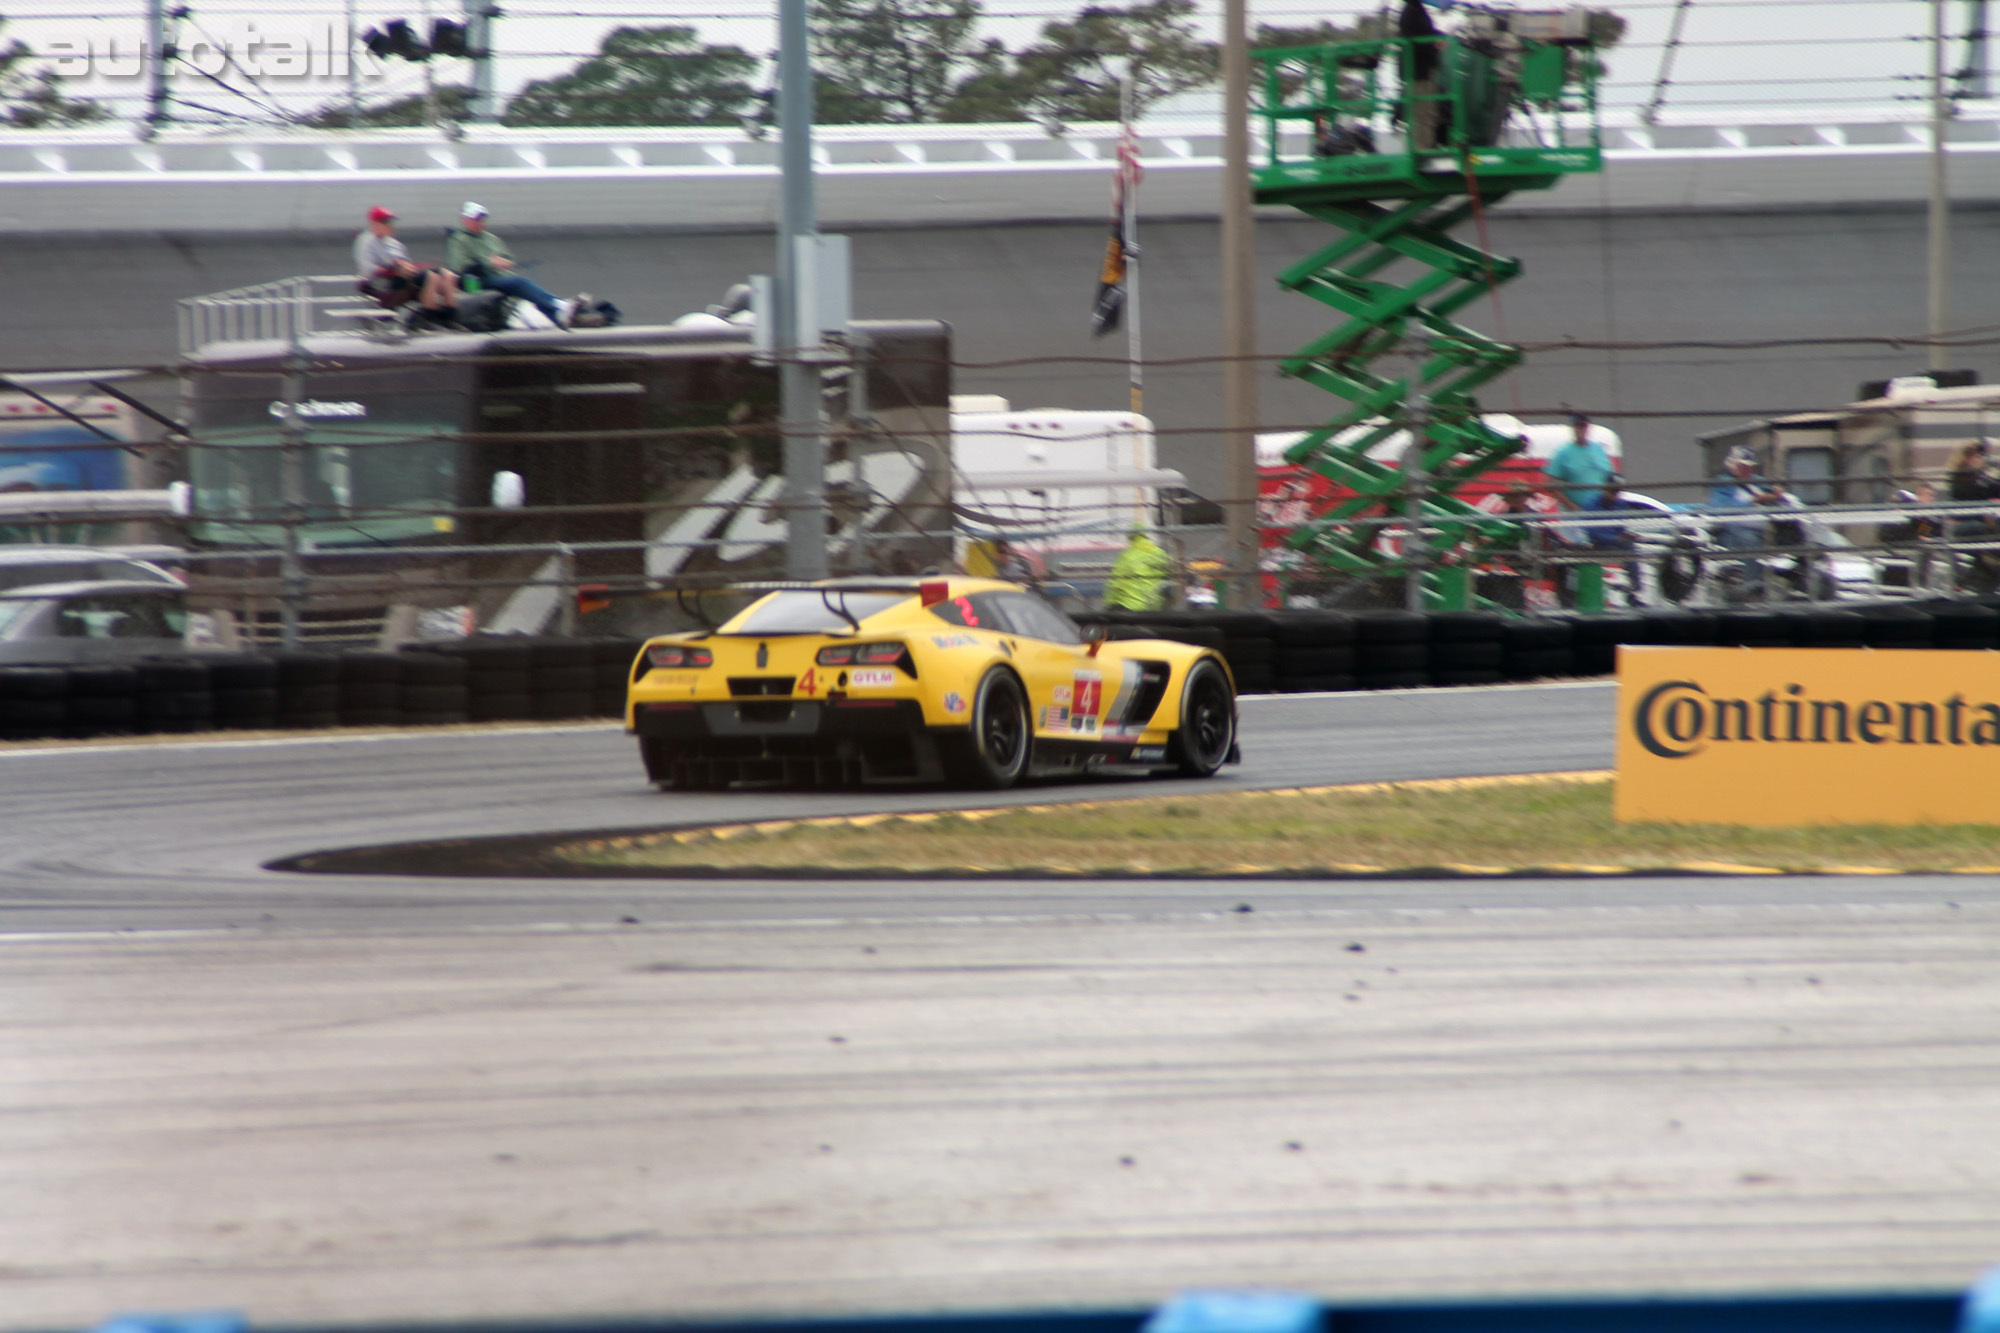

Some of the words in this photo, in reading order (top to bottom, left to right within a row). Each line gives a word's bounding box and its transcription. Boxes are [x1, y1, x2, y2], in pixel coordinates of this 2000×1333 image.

[798, 667, 816, 696] 4
[853, 671, 893, 685] GTLM
[1080, 680, 1093, 714] 4
[1634, 679, 2000, 759] Continenta
